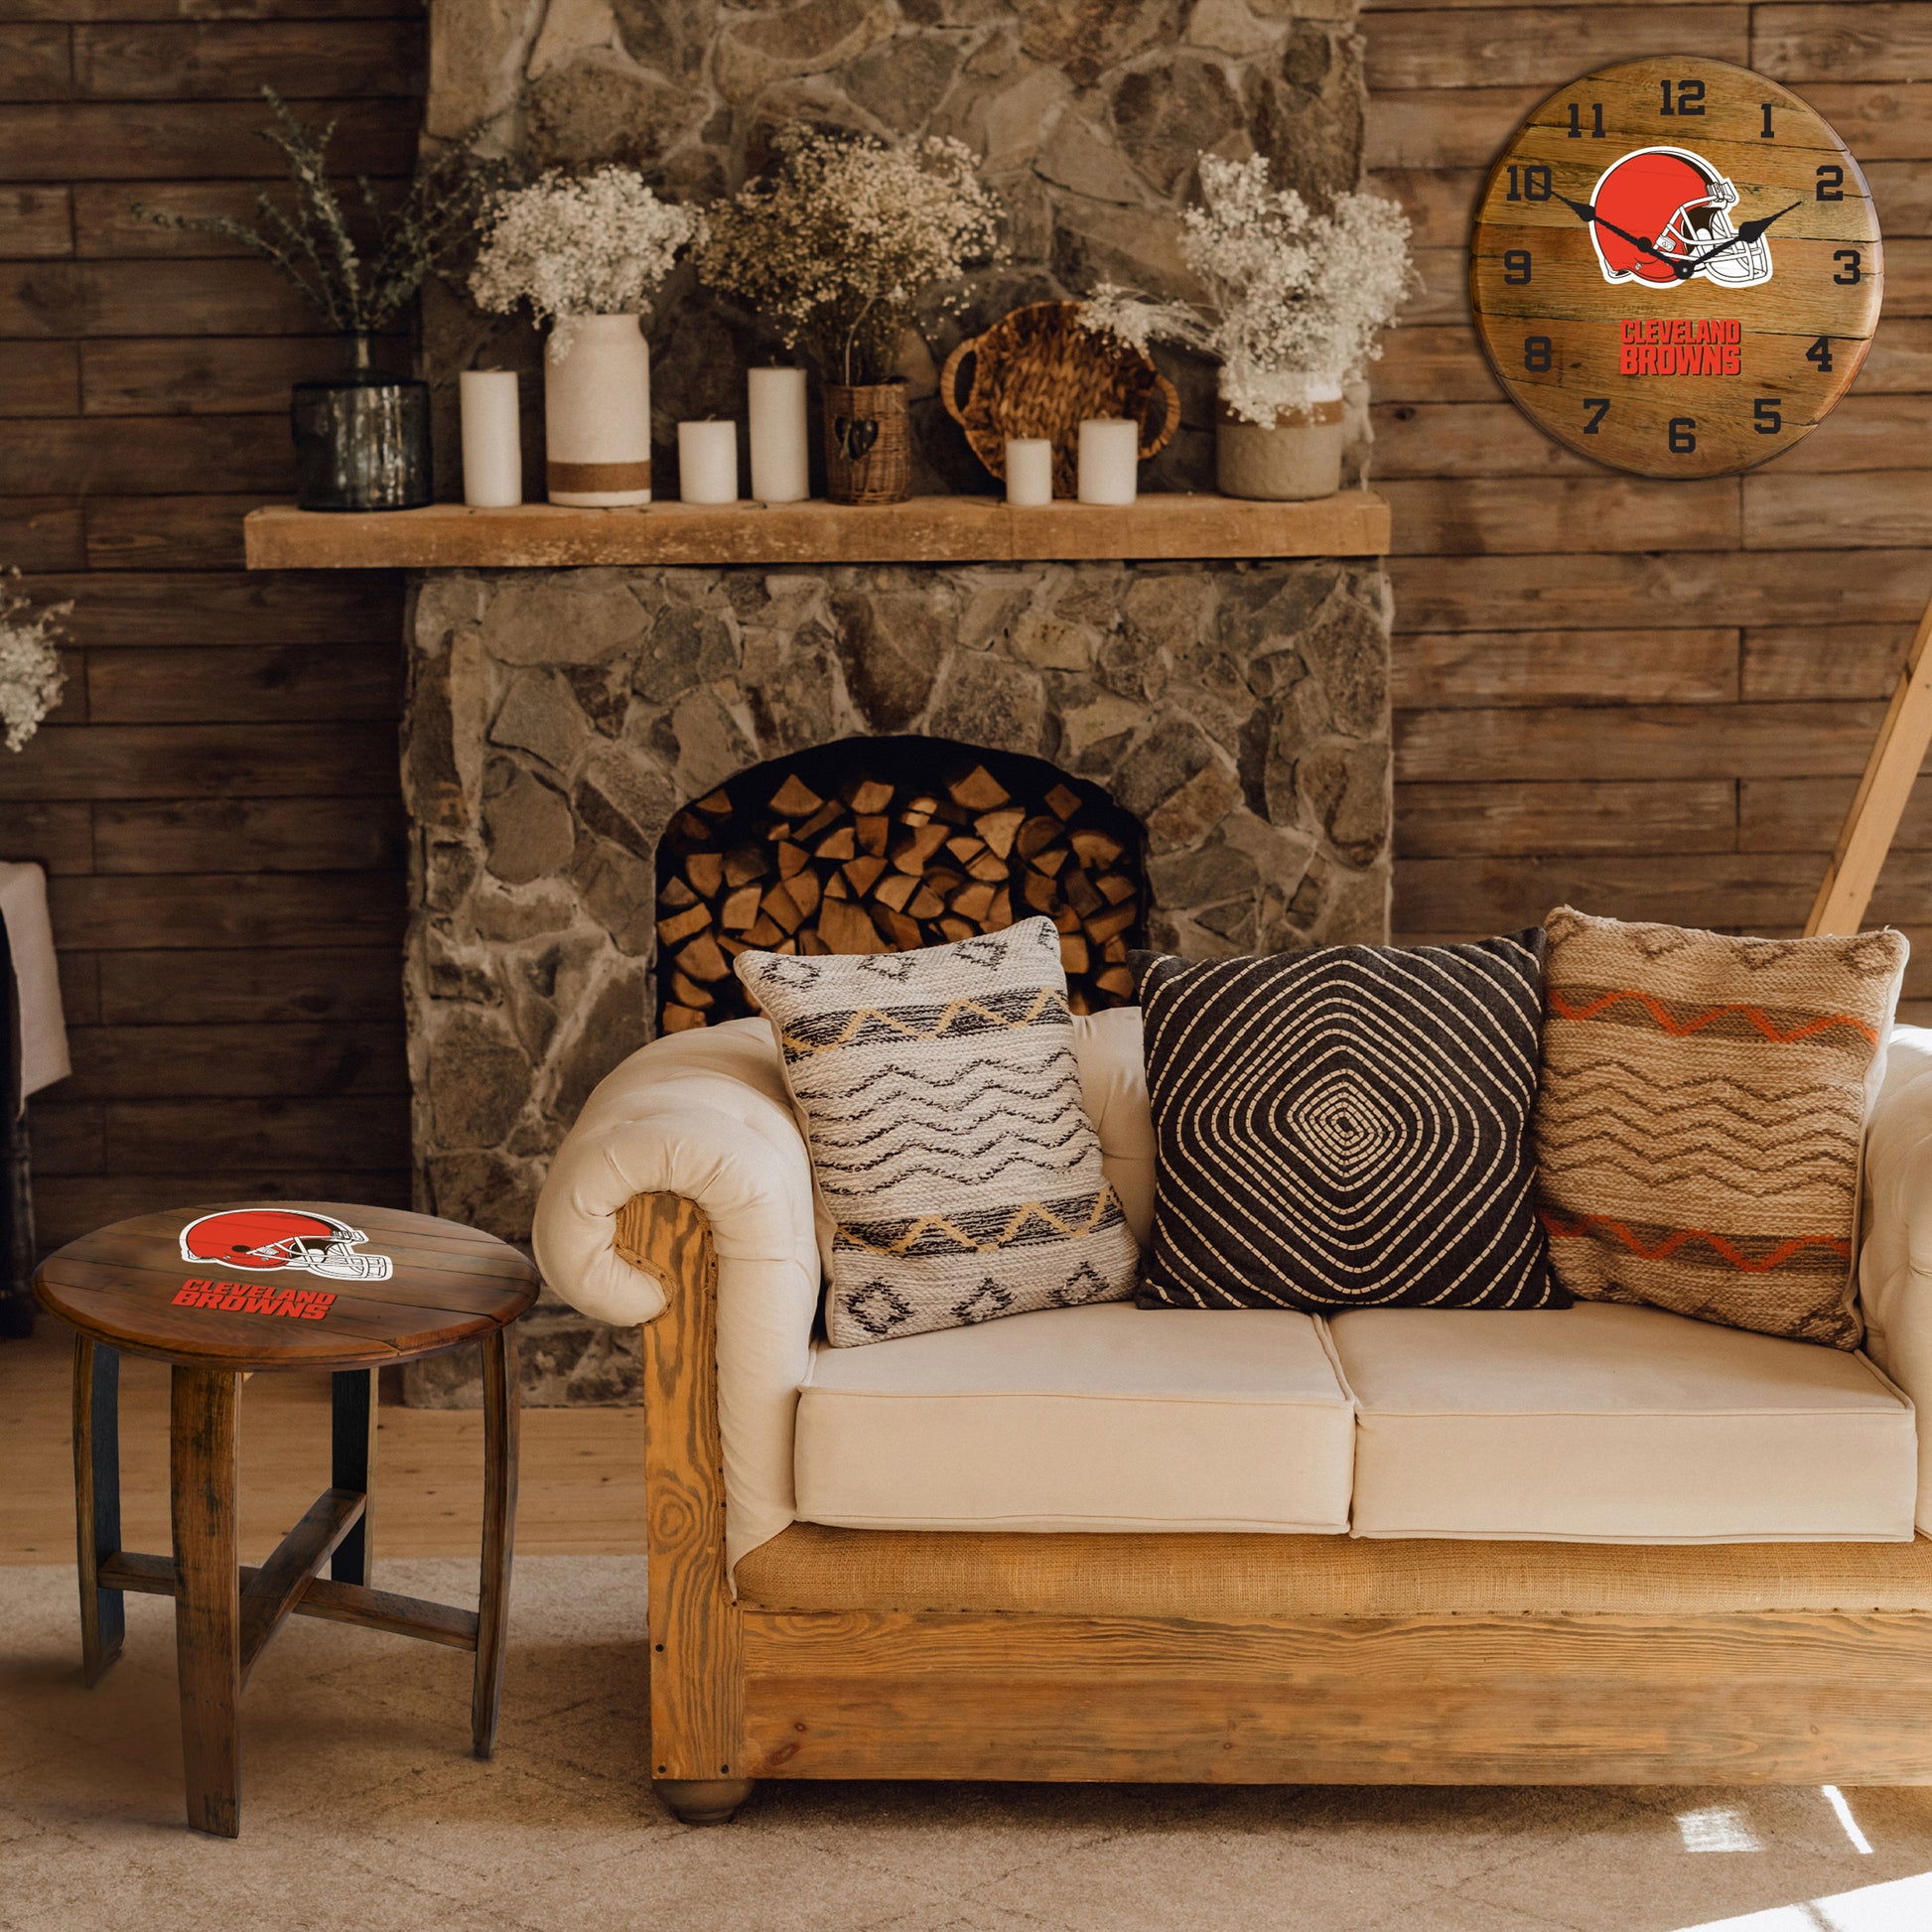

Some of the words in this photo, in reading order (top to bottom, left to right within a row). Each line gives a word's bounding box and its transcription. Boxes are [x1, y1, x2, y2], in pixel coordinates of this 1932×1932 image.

[1660, 79, 1706, 116] 12
[1568, 103, 1605, 138] 11
[1760, 103, 1775, 138] 1
[1506, 165, 1552, 202] 10
[1816, 165, 1844, 202] 2
[1504, 250, 1532, 285] 9
[1833, 250, 1861, 285] 3
[1619, 320, 1741, 345] CLEVELAND
[1524, 337, 1552, 372] 8
[1619, 345, 1741, 376] BROWNS
[1806, 337, 1833, 372] 4
[1584, 398, 1610, 435] 7
[1753, 398, 1781, 435] 5
[1669, 418, 1697, 454] 6
[171, 1291, 332, 1320] BROWNS
[182, 1279, 338, 1307] CLEVELAND
